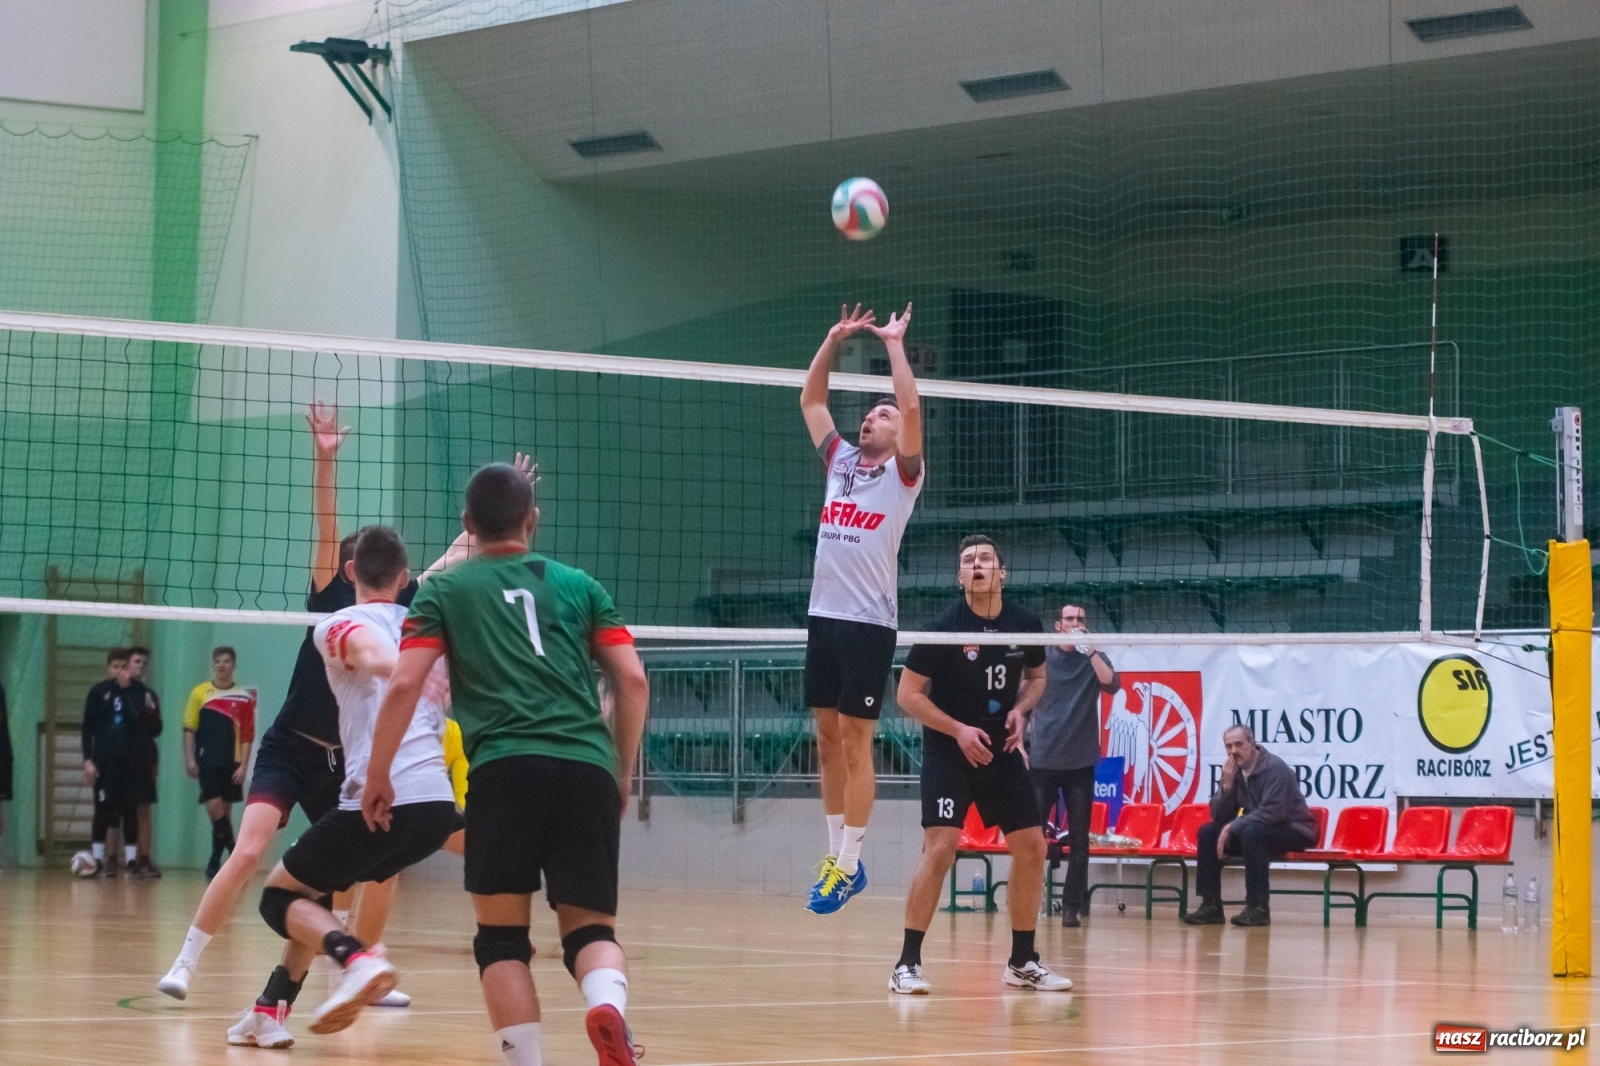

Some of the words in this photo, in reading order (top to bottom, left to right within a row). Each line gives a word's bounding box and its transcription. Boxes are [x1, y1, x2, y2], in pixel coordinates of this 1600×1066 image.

[843, 534, 860, 544] PBG
[502, 587, 546, 656] 7
[985, 664, 1007, 691] 13
[1230, 707, 1363, 744] MIASTO
[1208, 753, 1386, 800] RBÓRZ
[1417, 756, 1491, 777] RACIBÓRZ
[937, 798, 955, 819] 13
